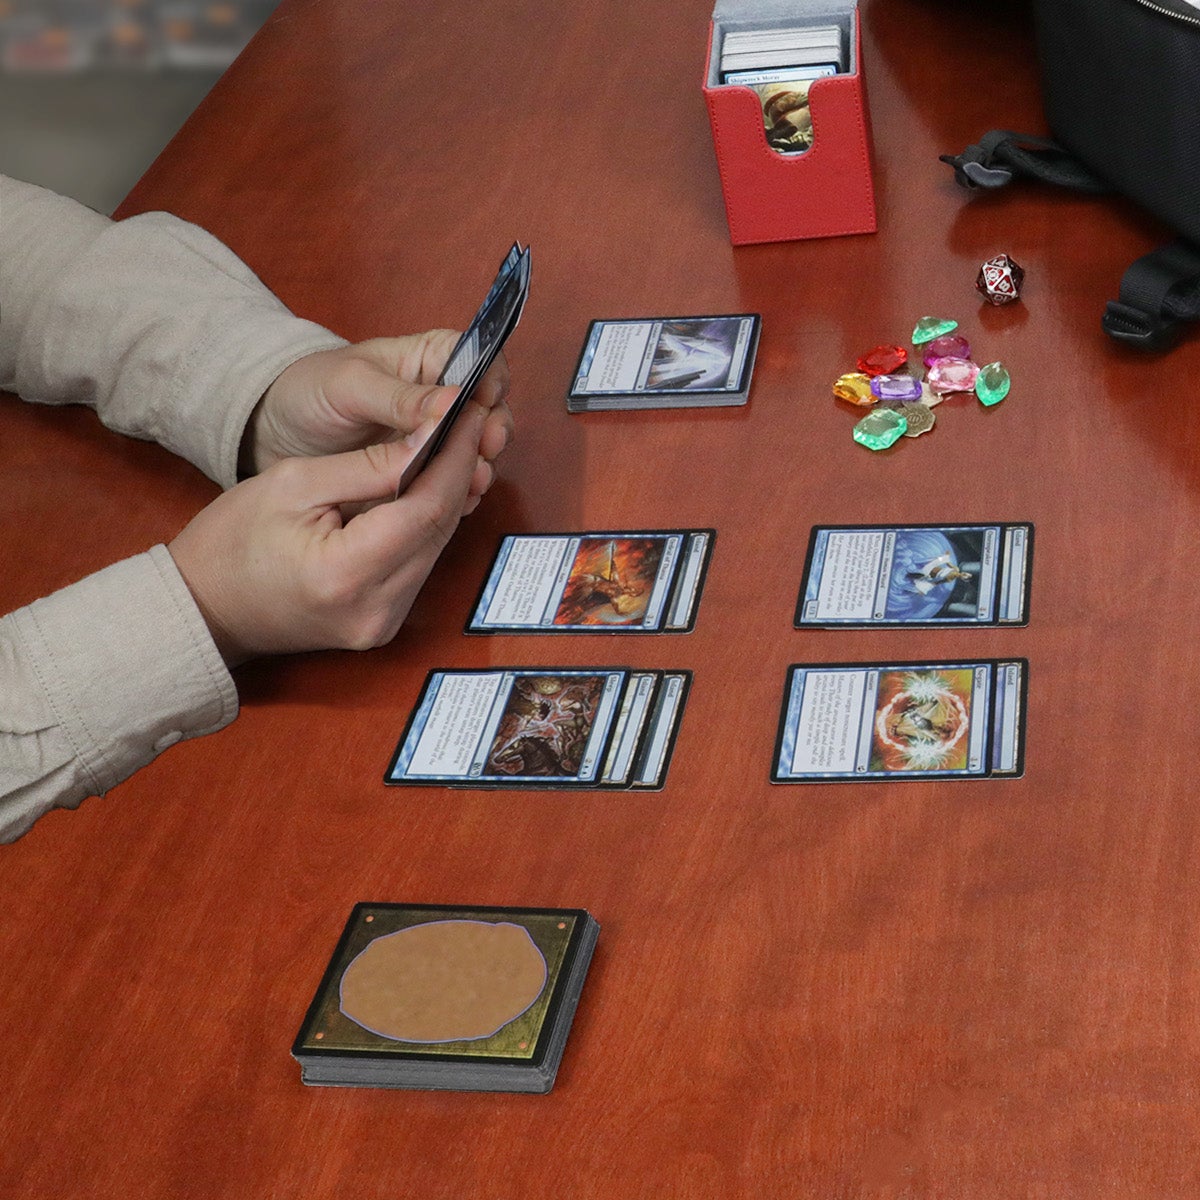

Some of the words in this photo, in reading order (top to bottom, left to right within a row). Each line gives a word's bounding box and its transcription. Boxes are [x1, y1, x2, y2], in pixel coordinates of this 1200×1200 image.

[693, 537, 702, 553] Island
[637, 678, 648, 696] Island
[667, 679, 678, 697] Island
[974, 669, 983, 689] Negate
